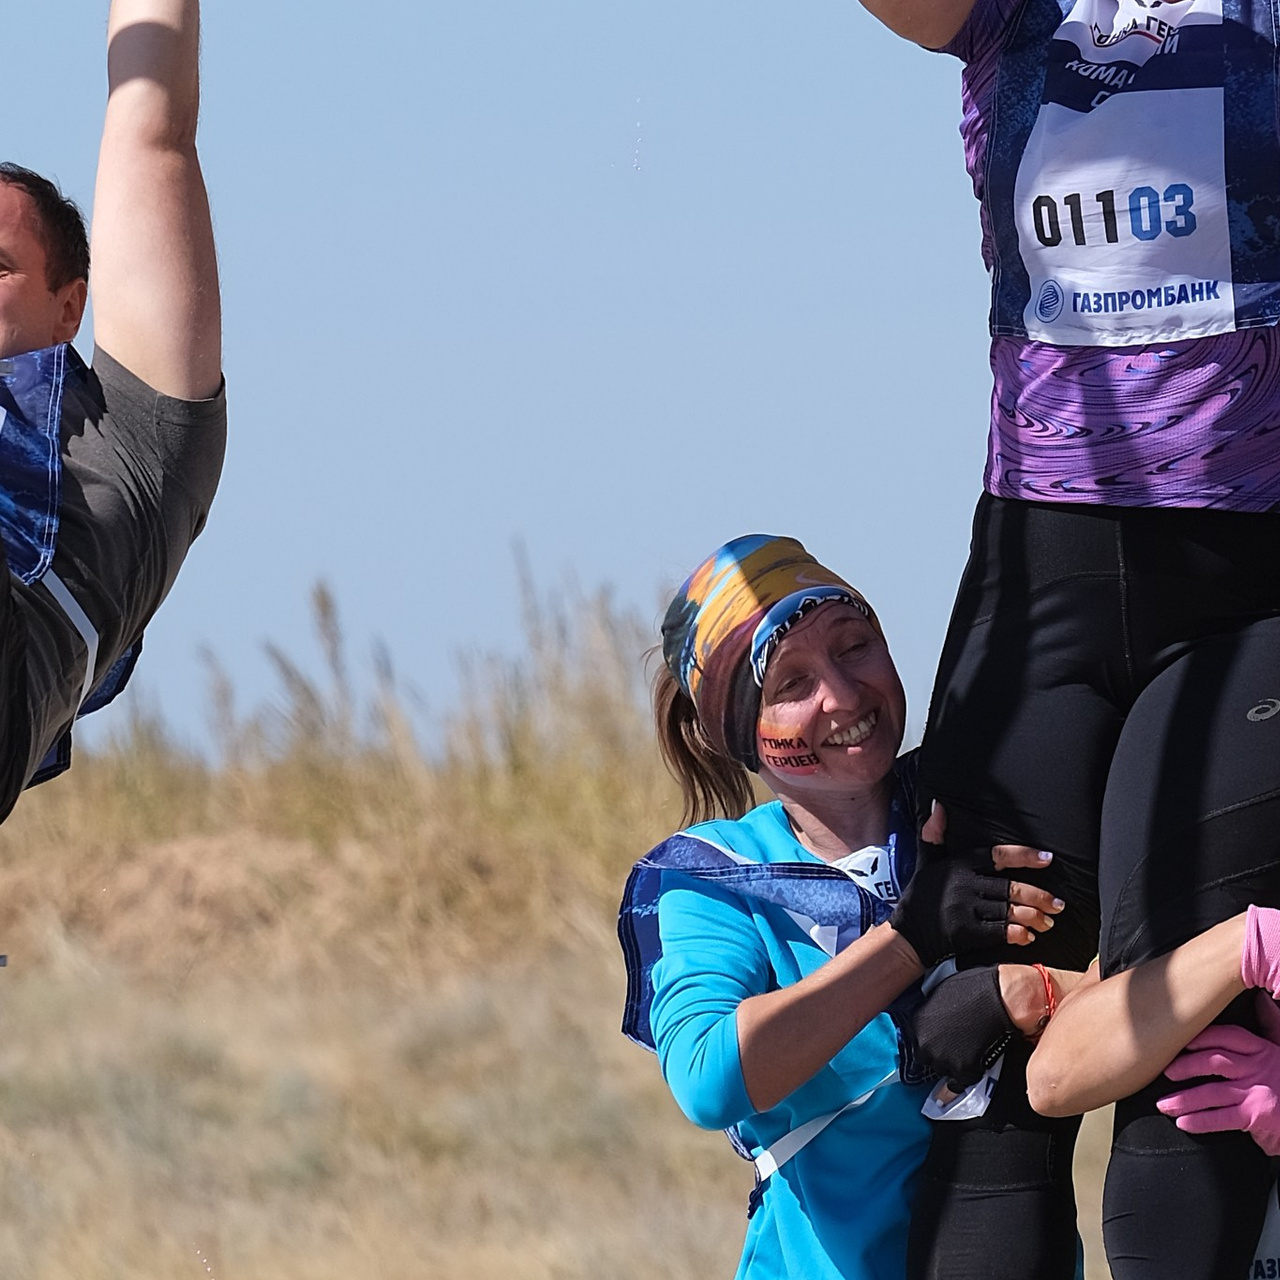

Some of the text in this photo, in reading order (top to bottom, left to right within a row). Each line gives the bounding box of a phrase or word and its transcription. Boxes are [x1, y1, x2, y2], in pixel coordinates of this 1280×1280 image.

[1033, 184, 1197, 247] 01103
[1072, 281, 1220, 314] ГАЗПРОМБАНК
[762, 737, 808, 750] ГОНКА
[765, 754, 820, 768] ГЕРОЕВ
